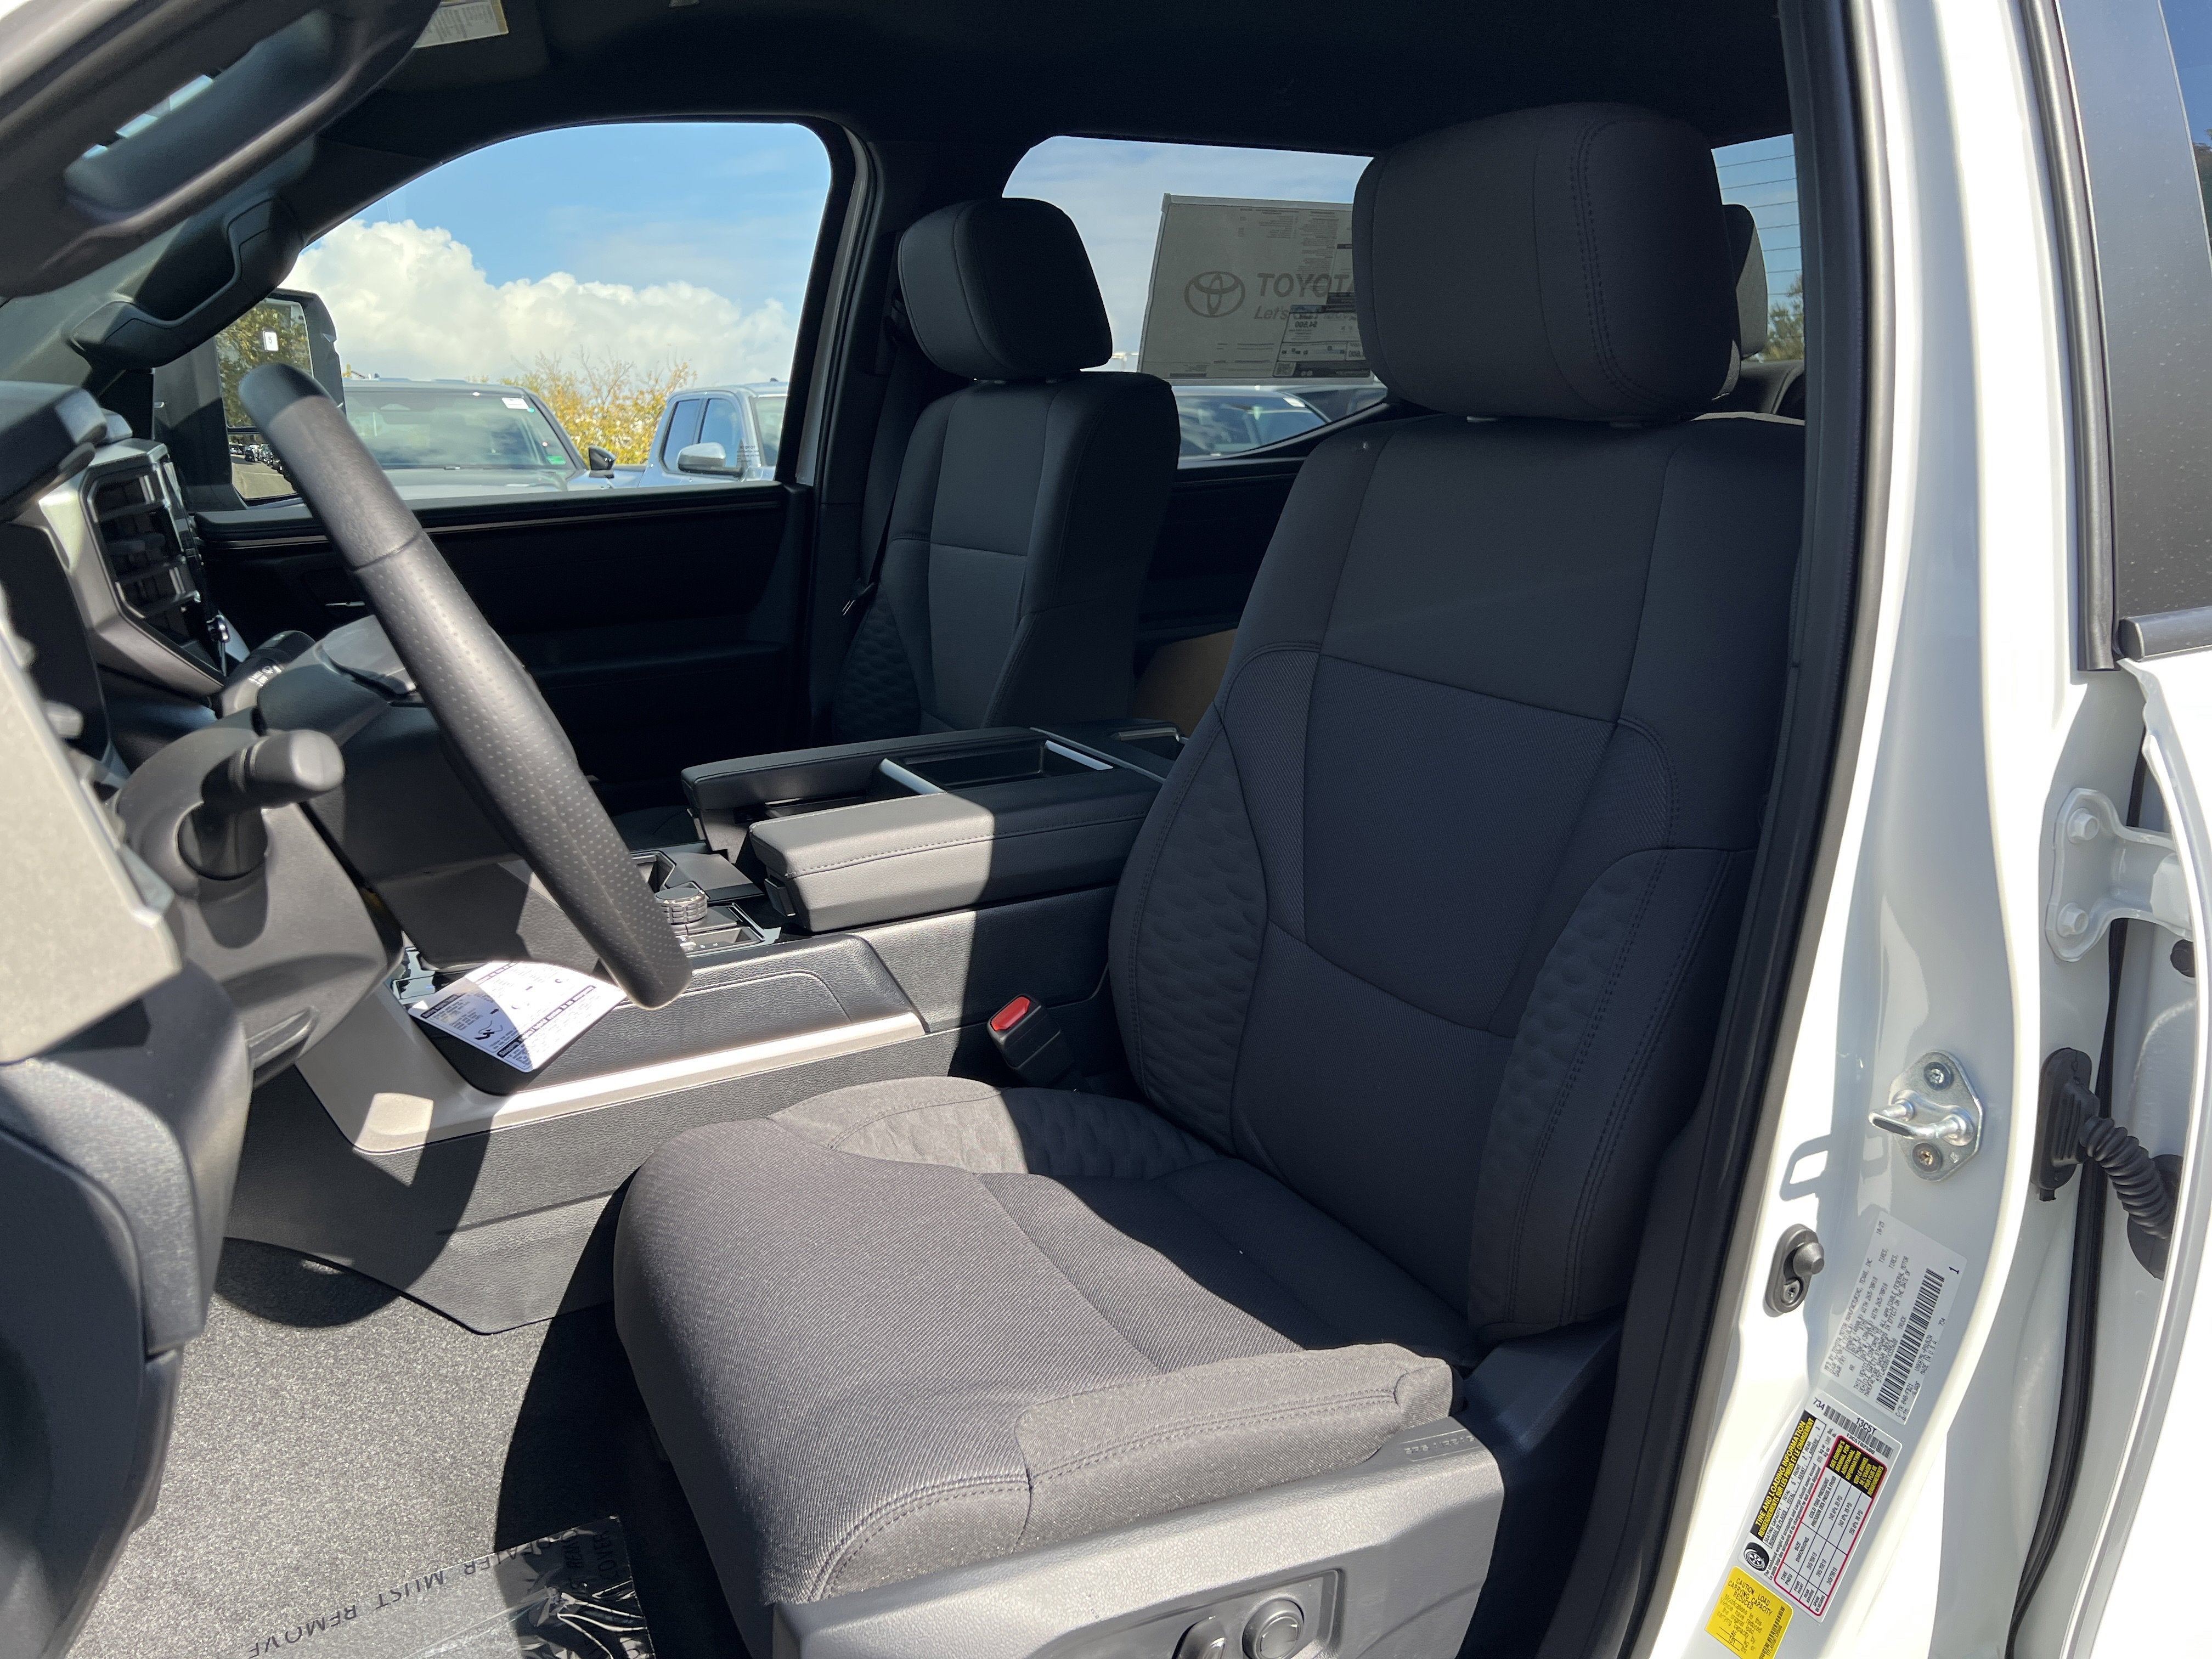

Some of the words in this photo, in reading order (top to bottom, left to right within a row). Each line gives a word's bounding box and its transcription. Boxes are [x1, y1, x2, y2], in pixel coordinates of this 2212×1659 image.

[1948, 1265, 1959, 1274] 1
[1853, 1378, 1861, 1390] THIS
[1859, 1358, 1870, 1378] VEHICLE
[1883, 1291, 1897, 1317] APPLICABLE
[1893, 1271, 1904, 1290] FEDERAL
[1899, 1255, 1909, 1270] MOTOR
[1898, 1315, 1906, 1329] TRUCK
[1832, 1336, 1841, 1353] TOYOTA
[1838, 1322, 1847, 1336] MOTOR
[1859, 1374, 1870, 1393] VEHICLE
[1867, 1357, 1877, 1373] SAFETY
[1887, 1307, 1897, 1323] EFFECT
[1900, 1277, 1908, 1288] DATE
[1864, 1367, 1879, 1397] MANUFACTURE
[1876, 1351, 1885, 1366] SHOWN
[1812, 1397, 1825, 1410] 734
[1855, 1418, 1876, 1435] 13C5T
[1833, 1440, 1845, 1460] OWNER'S
[1841, 1449, 1855, 1474] ADDITIONAL
[1755, 1510, 1765, 1526] TIRE
[1762, 1496, 1772, 1511] AND
[1768, 1466, 1785, 1496] LOADING
[1781, 1420, 1805, 1466] INFORMATION
[1797, 1466, 1805, 1480] AVANT
[1835, 1453, 1846, 1471] MANUAL
[1845, 1451, 1861, 1480] INFORMATION
[1859, 1457, 1868, 1471] MANUEL
[1757, 1496, 1779, 1537] RENSEIGNEMENTS
[1775, 1486, 1784, 1497] SUR
[1784, 1462, 1795, 1478] PNEUS
[1796, 1417, 1814, 1449] CHARGEMENT
[1817, 1477, 1829, 1498] PRESSURE
[1863, 1479, 1871, 1489] POUR
[1867, 1465, 1883, 1496] RENSEIGNEMENTS
[1764, 1526, 1774, 1543] SEATING
[1771, 1507, 1782, 1526] CAPACITY
[1767, 1551, 1777, 1570] combined
[1775, 1539, 1783, 1553] weight
[1782, 1517, 1793, 1536] occupants
[1808, 1463, 1816, 1476] exceed
[1768, 1529, 1778, 1545] NOMBRE
[1778, 1509, 1786, 1524] PLACES
[1811, 1509, 1821, 1527] PRESSION
[1795, 1537, 1809, 1562] DIMENSIONS
[1724, 1594, 1748, 1615] Modifications
[1728, 1580, 1750, 1600] CARRYING
[1751, 1597, 1772, 1616] CAPACITY
[1733, 1591, 1753, 1609] REDUCED
[1757, 1594, 1770, 1606] LOAD
[1716, 1611, 1732, 1626] carrying
[1733, 1623, 1749, 1638] capacity
[1730, 1614, 1744, 1627] original
[1745, 1624, 1754, 1634] load
[1735, 1610, 1745, 1620] have
[1746, 1618, 1762, 1633] reduced
